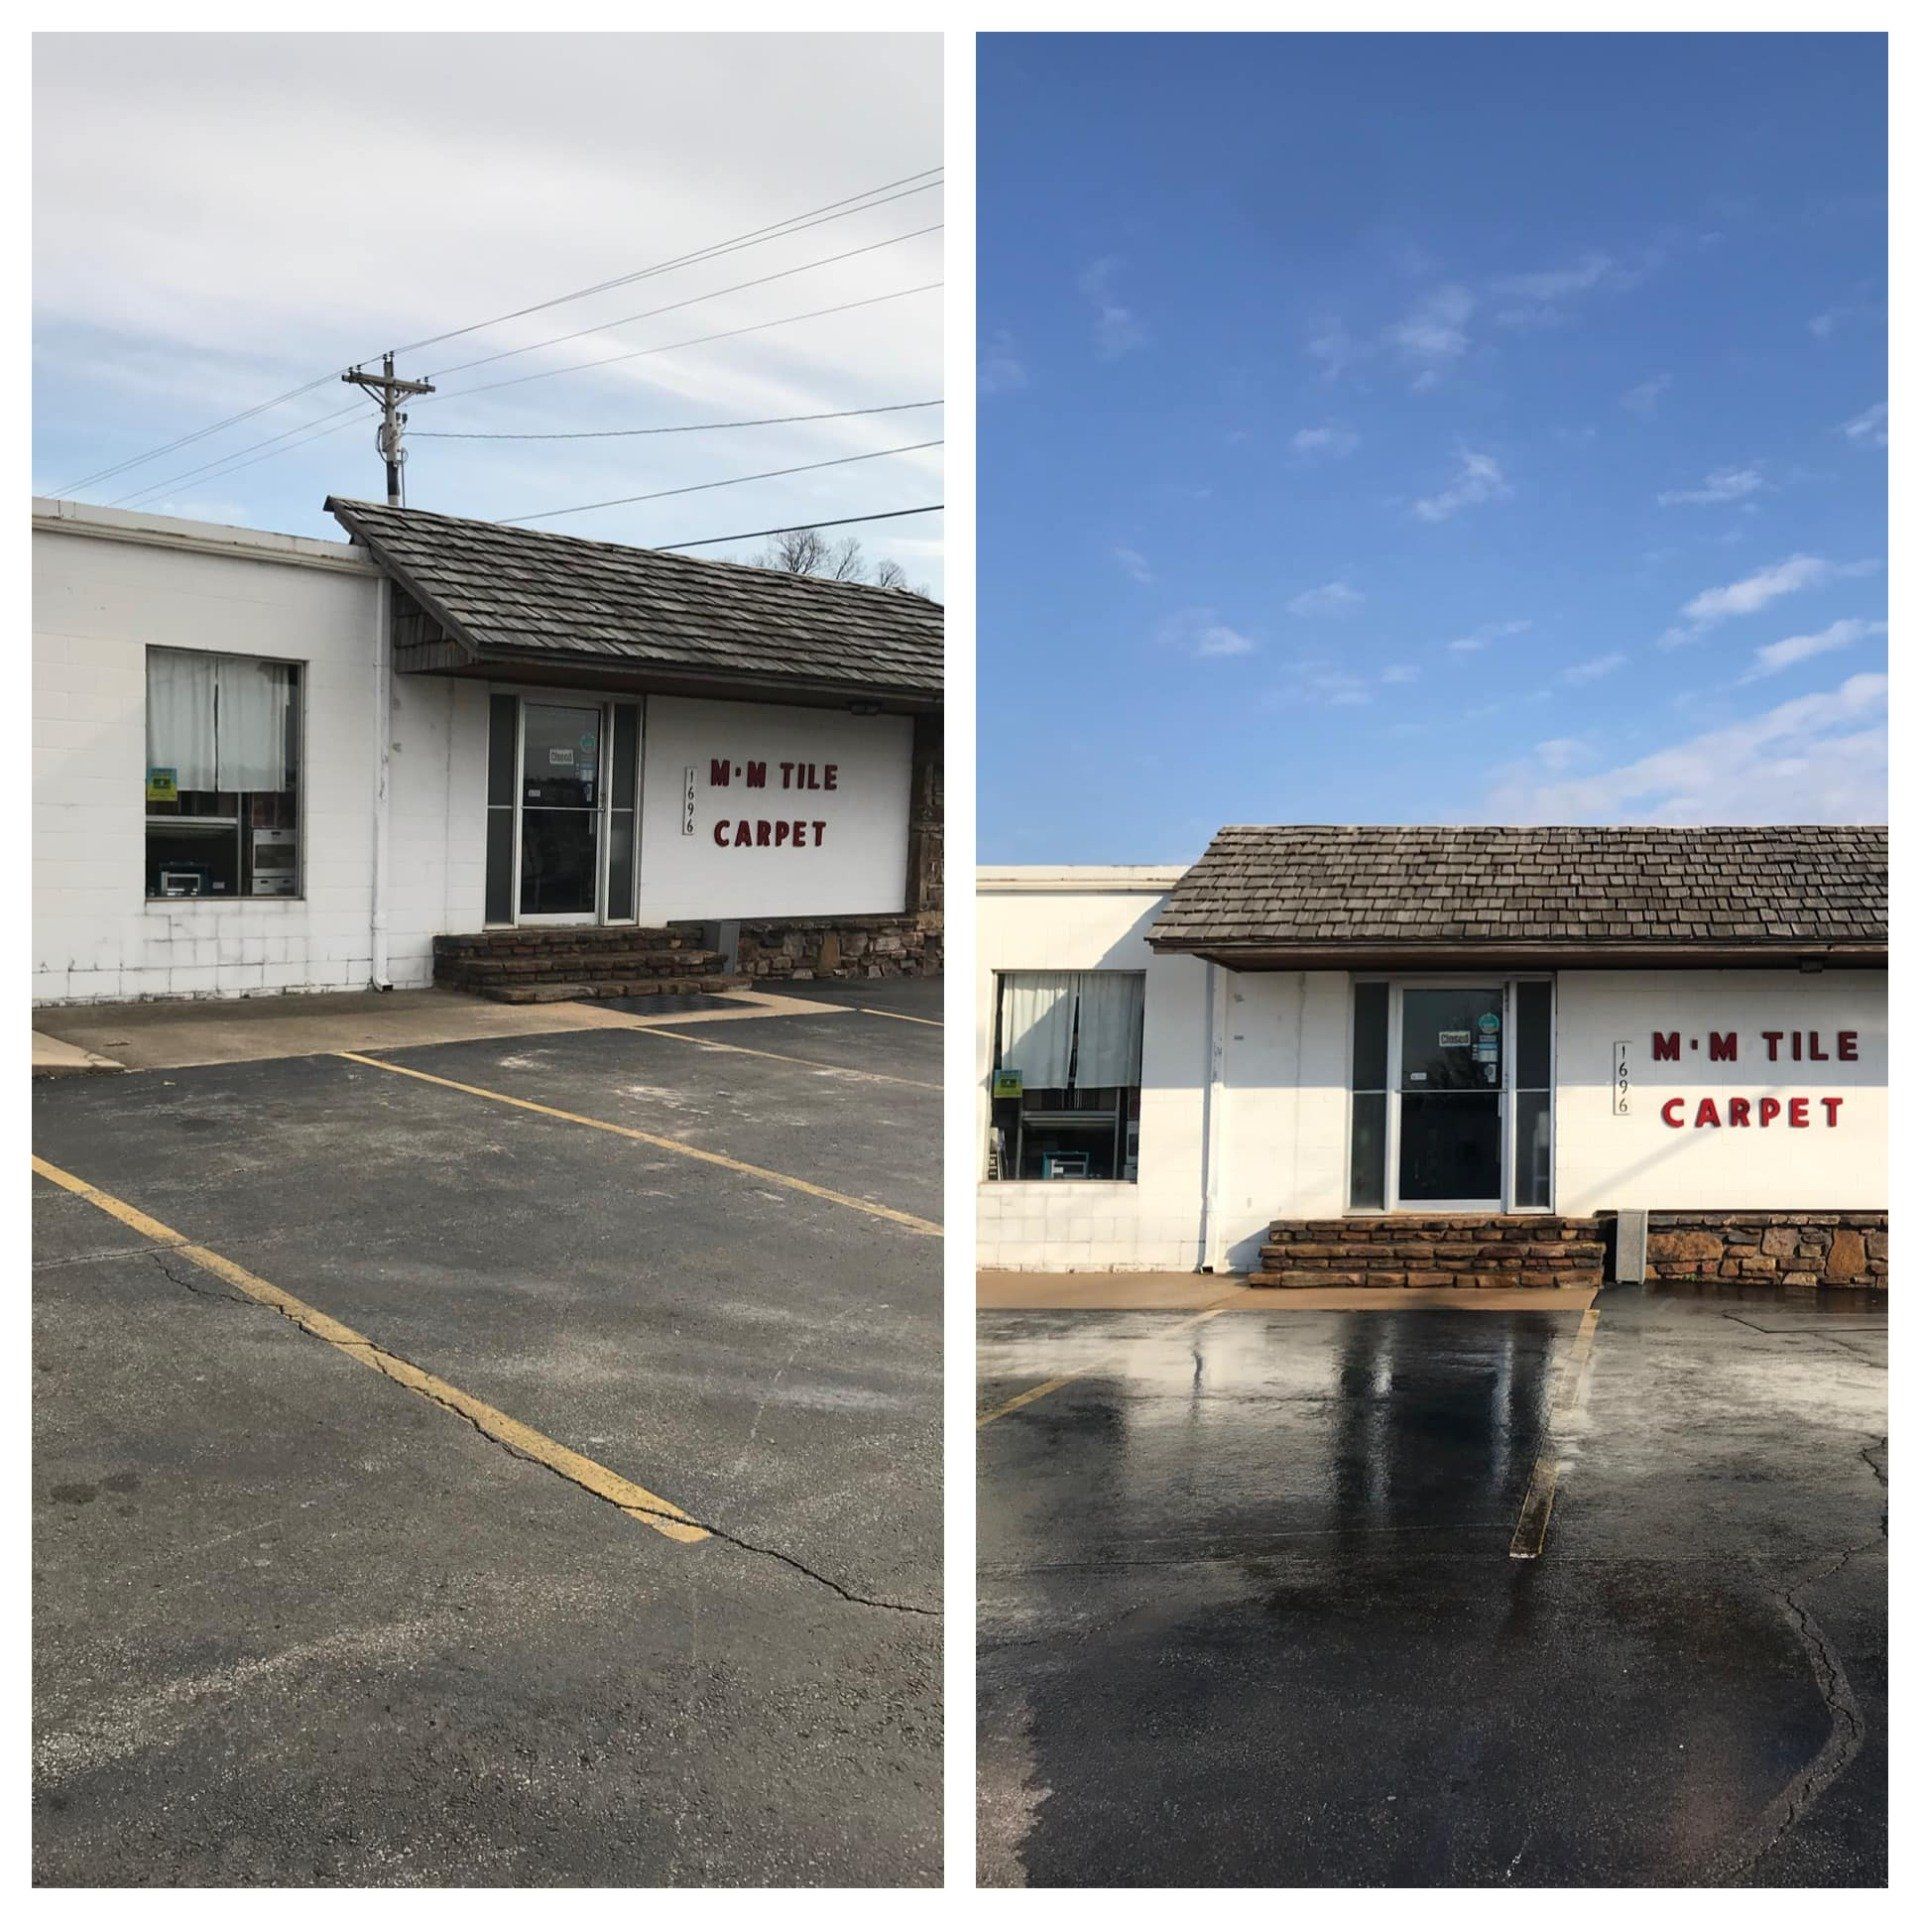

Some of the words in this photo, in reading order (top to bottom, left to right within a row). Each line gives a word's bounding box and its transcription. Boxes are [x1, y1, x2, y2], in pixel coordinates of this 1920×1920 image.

[779, 762, 838, 791] TILE
[686, 770, 695, 834] 1696
[714, 820, 827, 847] CARPET
[1762, 1031, 1858, 1061] TILE
[1618, 1045, 1628, 1113] 1696
[1661, 1097, 1843, 1128] CARPET
